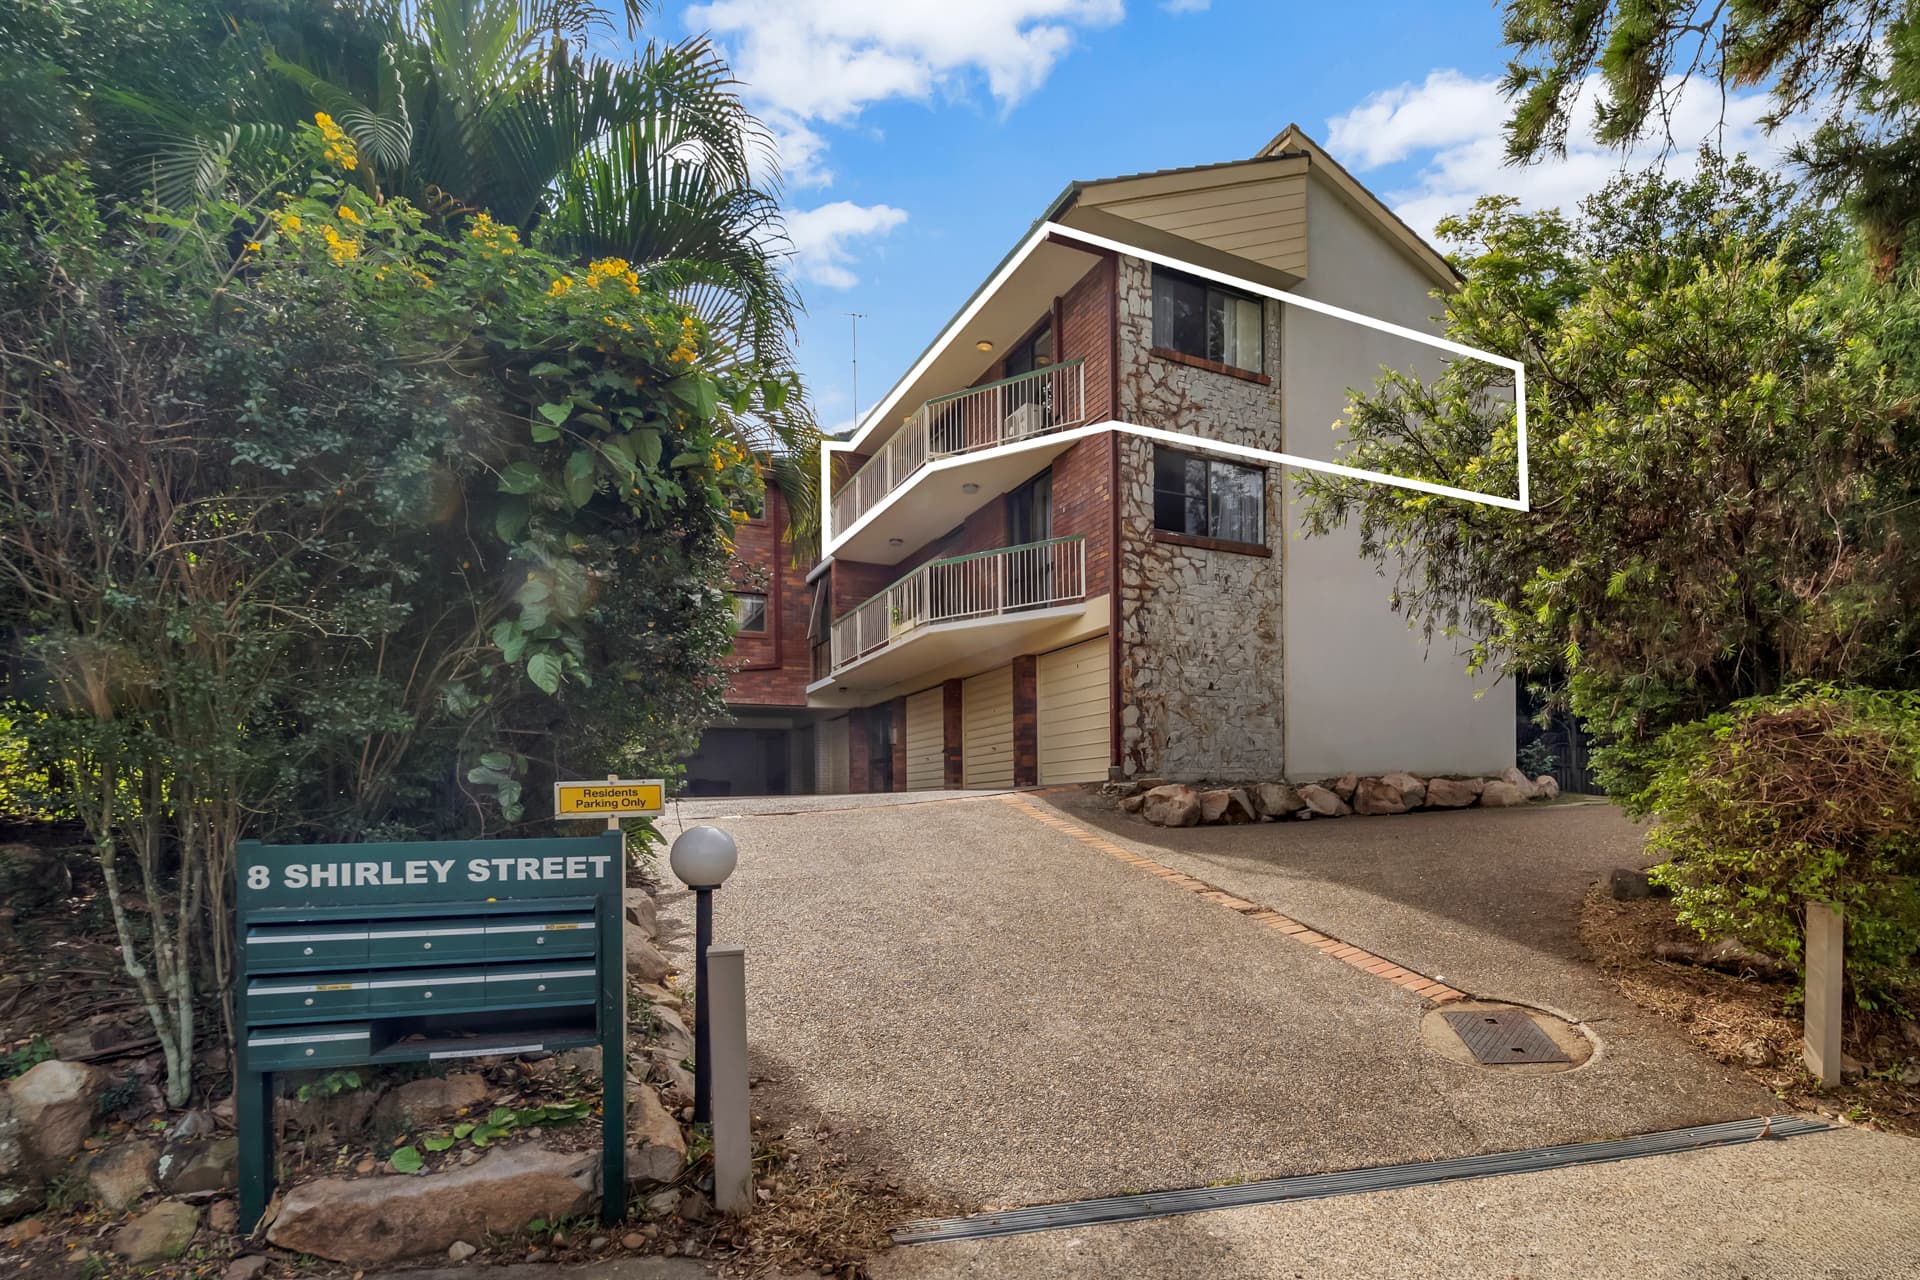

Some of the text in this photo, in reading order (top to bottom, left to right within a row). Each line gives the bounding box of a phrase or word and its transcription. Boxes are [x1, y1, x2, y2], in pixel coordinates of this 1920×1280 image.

[583, 788, 638, 798] Residents
[576, 797, 646, 809] Parking Only
[247, 855, 611, 890] 8 SHIRLEY STREET
